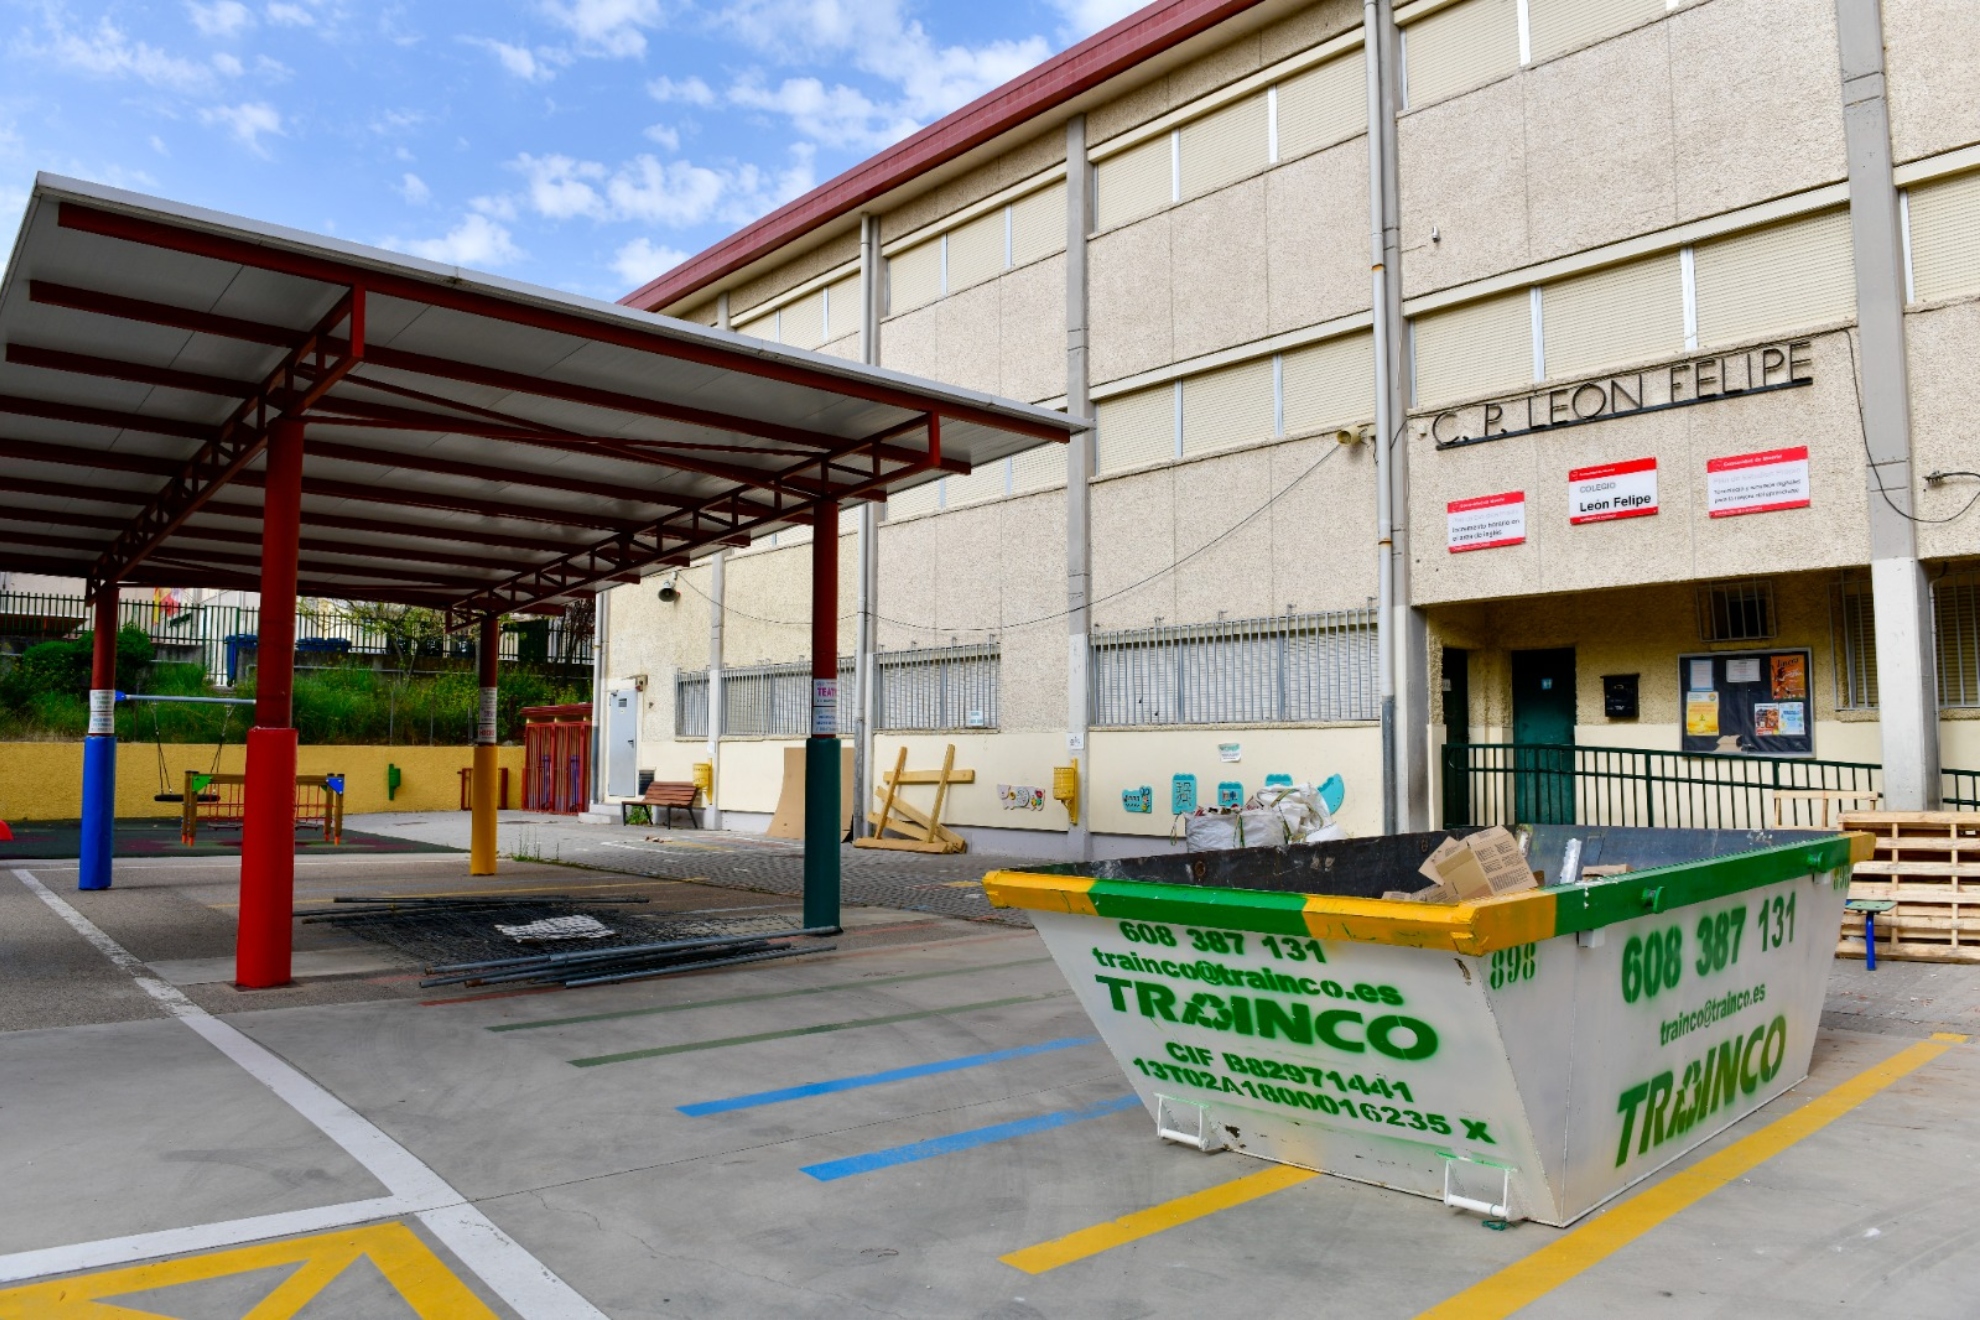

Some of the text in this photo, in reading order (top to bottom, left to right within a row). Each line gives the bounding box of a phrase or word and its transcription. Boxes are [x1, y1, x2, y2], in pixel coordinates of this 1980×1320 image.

[1432, 341, 1812, 446] C. P. LEON FELIPE
[1580, 482, 1616, 493] COLEGIO
[1580, 494, 1652, 512] León Felipe
[1119, 920, 1328, 964] 608 387 131
[1490, 942, 1537, 990] 898
[1621, 891, 1797, 1004] 608 387 131
[1092, 946, 1405, 1006] trainco@trainco.es
[1095, 974, 1439, 1062] TRAINCO
[1660, 984, 1766, 1046] trainco@trainco.es
[1165, 1041, 1415, 1103] CIF B82971441
[1615, 1014, 1788, 1168] TRAINCO
